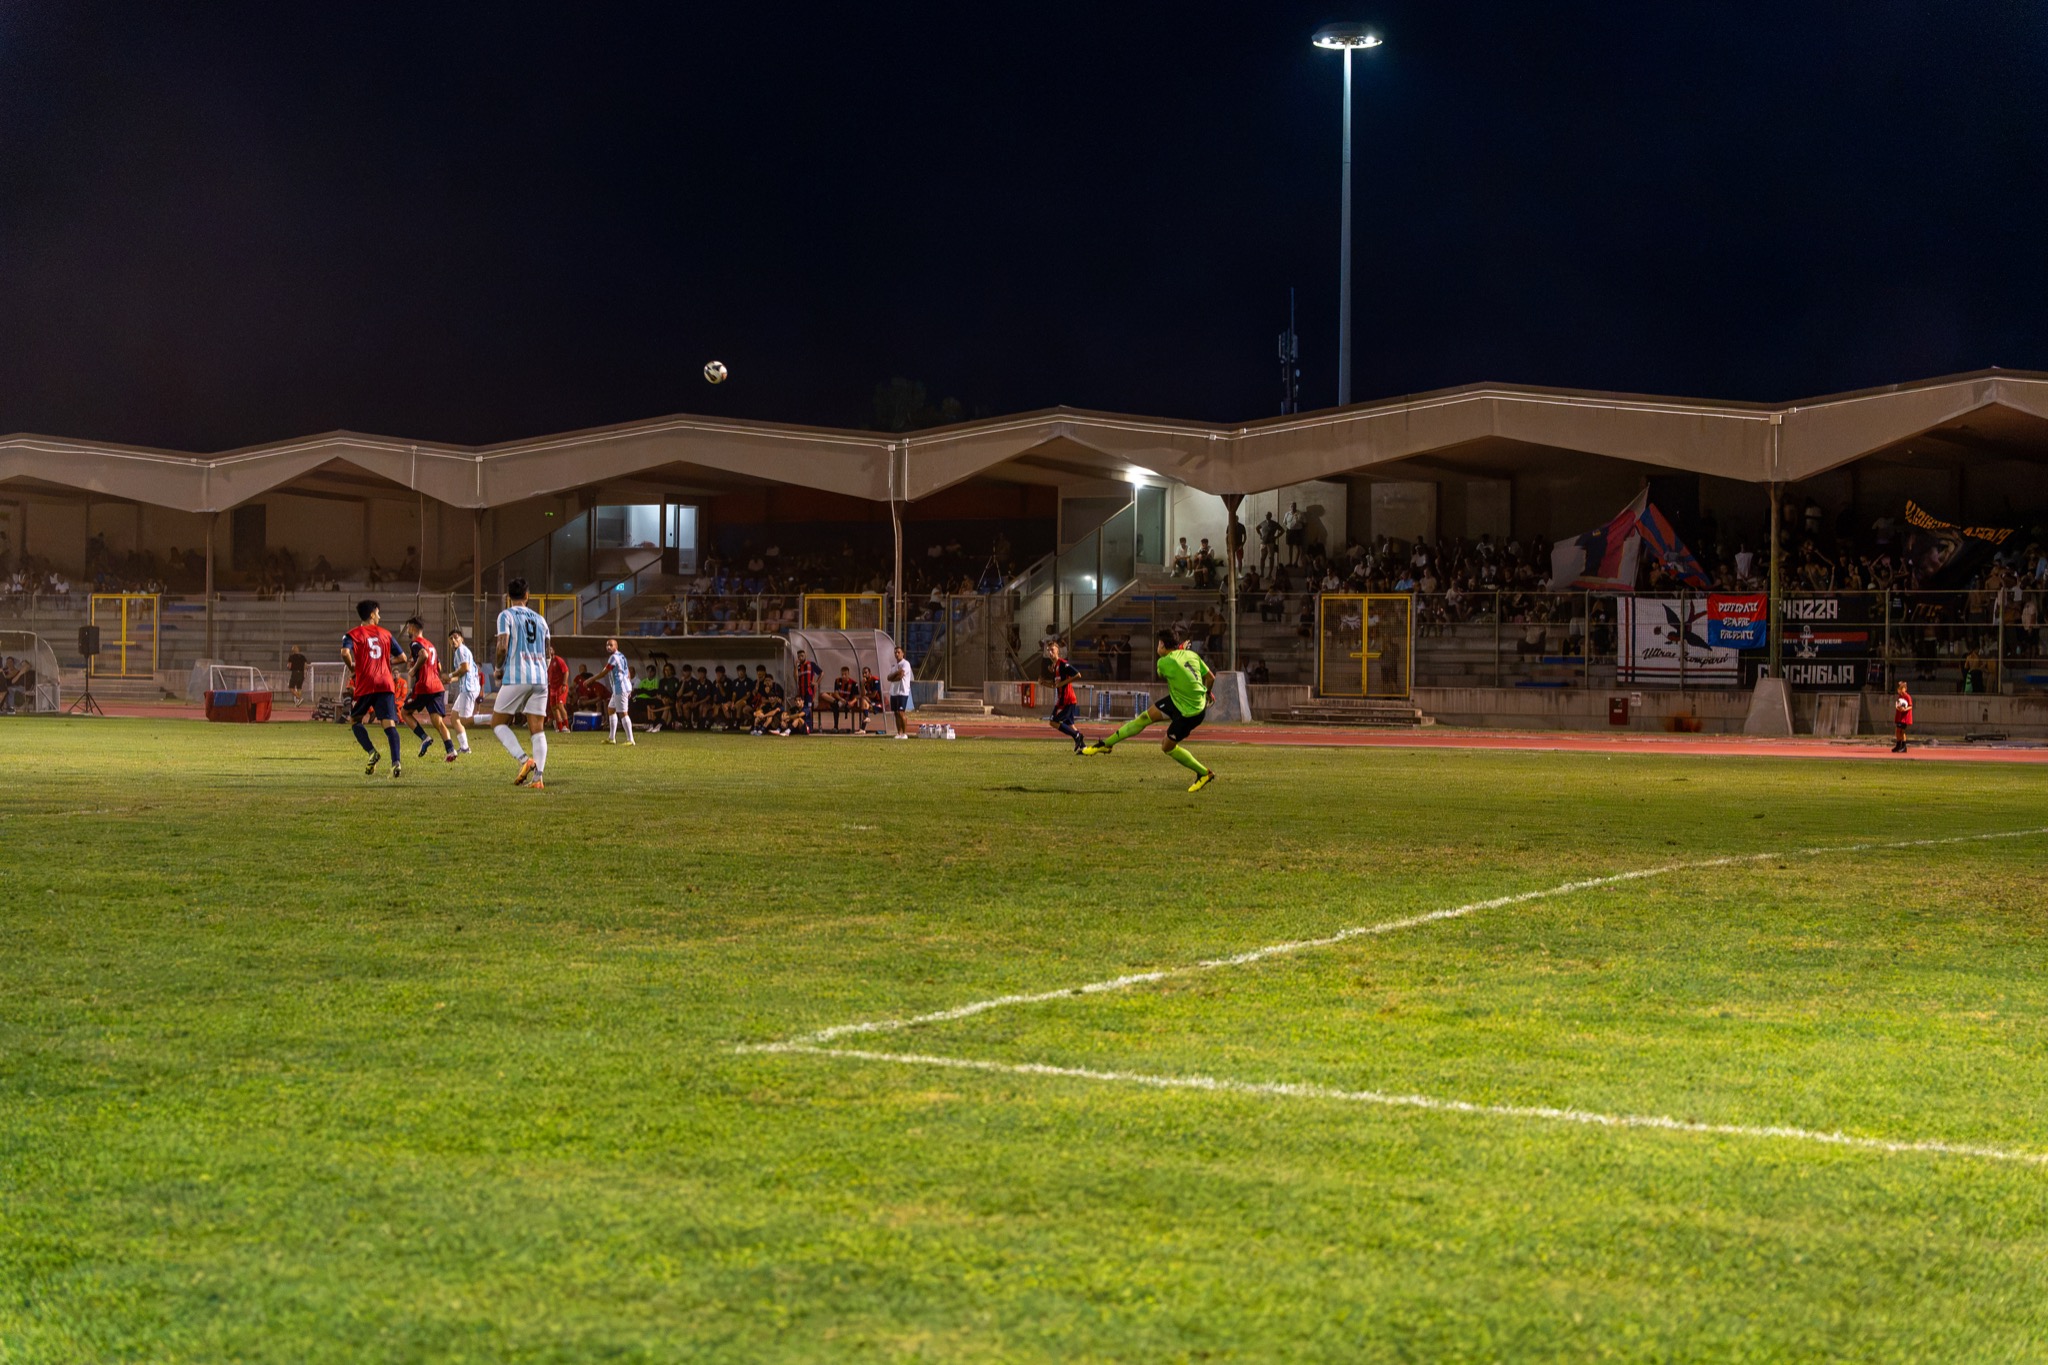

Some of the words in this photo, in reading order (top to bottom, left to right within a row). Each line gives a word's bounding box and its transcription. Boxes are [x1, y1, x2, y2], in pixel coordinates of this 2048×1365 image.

[525, 619, 536, 643] 9
[367, 637, 382, 660] 5
[428, 646, 436, 665] 7
[1184, 661, 1199, 681] 1
[1757, 664, 1855, 685] CNCHIGLIA
